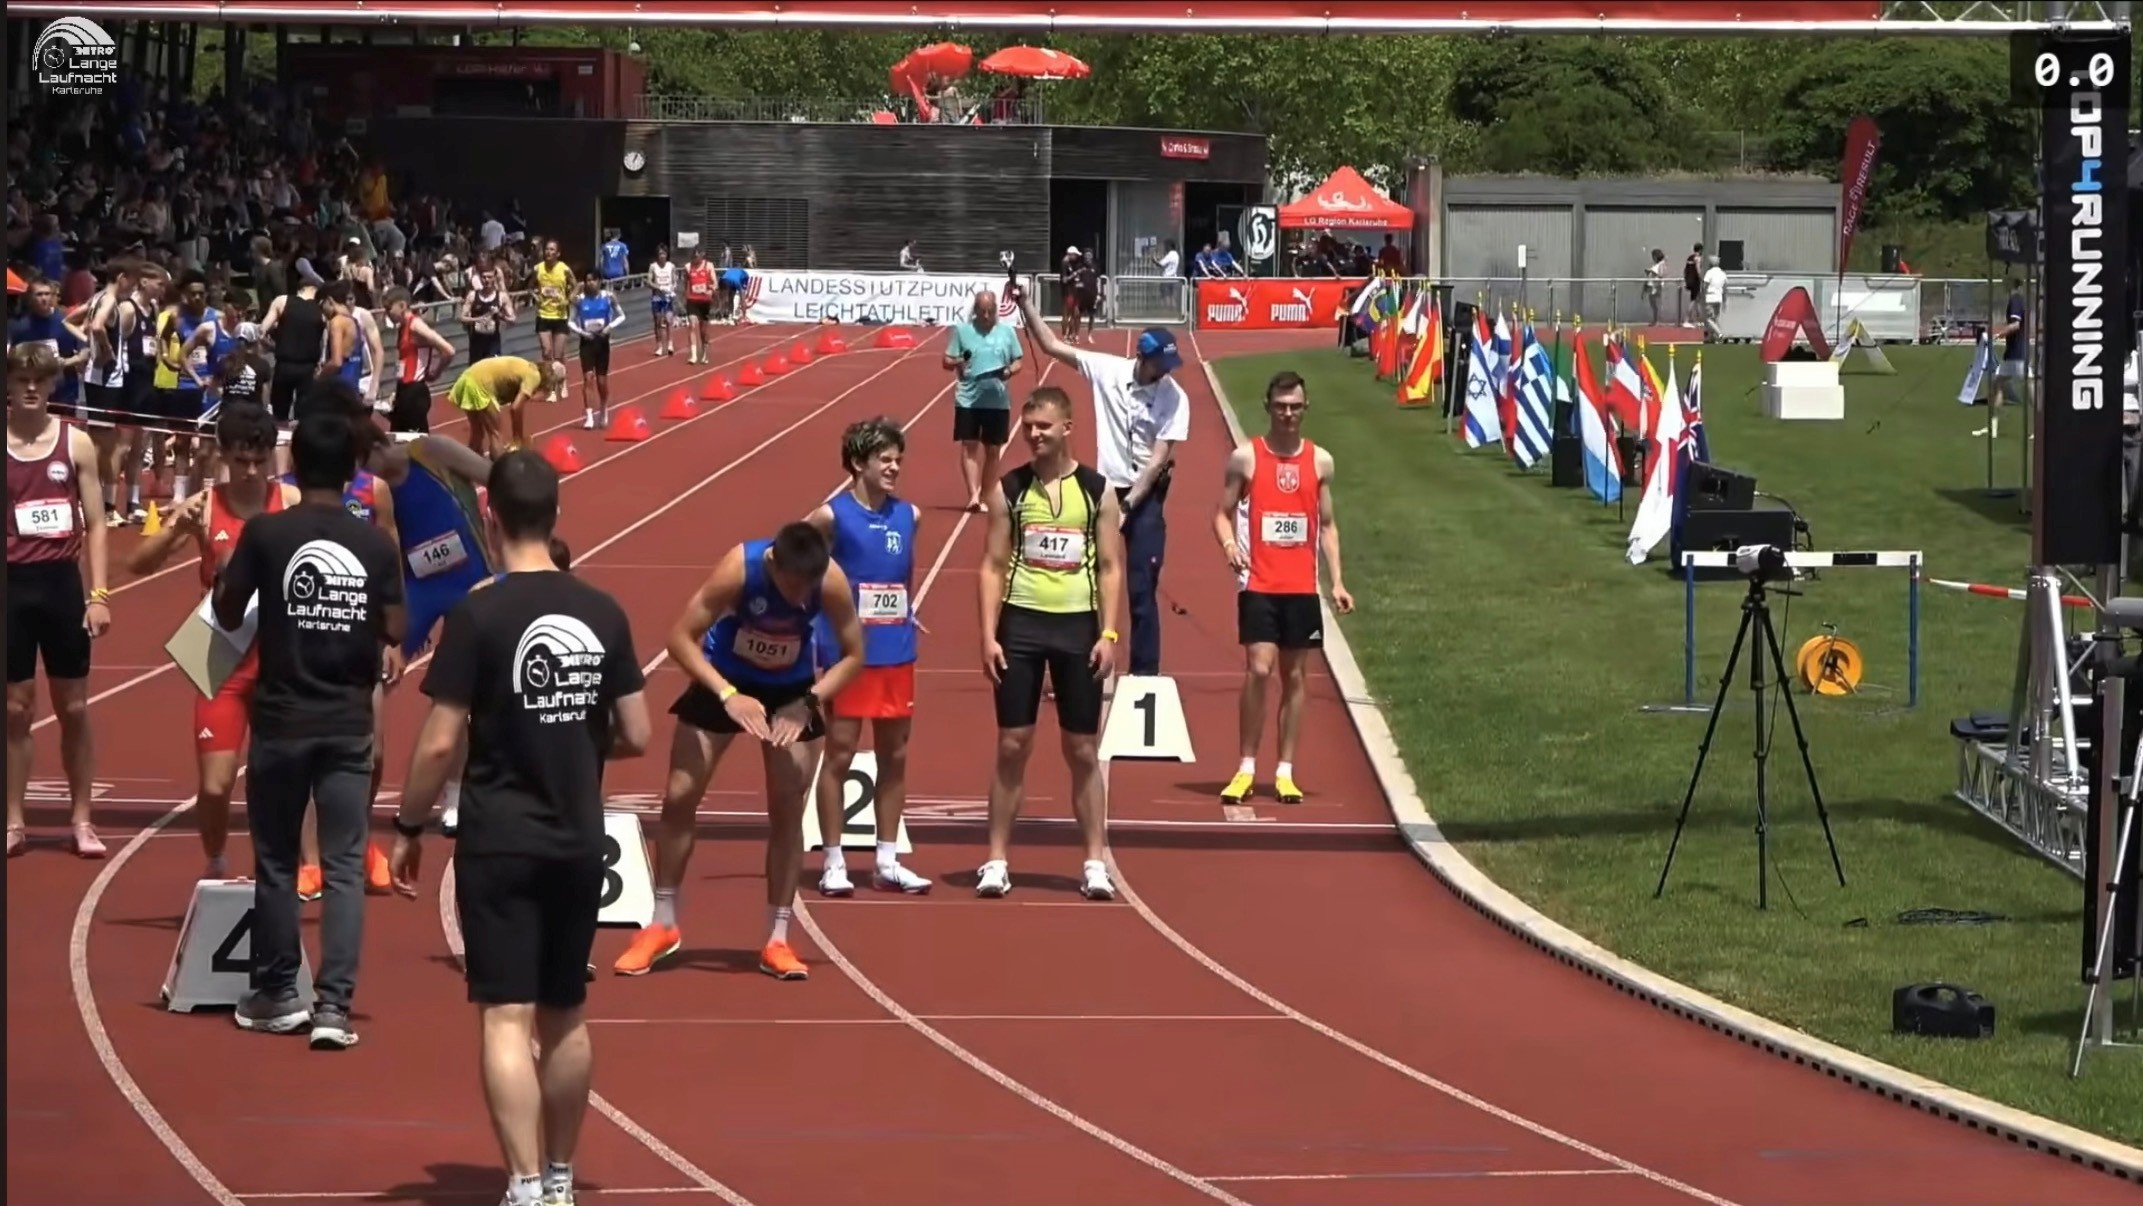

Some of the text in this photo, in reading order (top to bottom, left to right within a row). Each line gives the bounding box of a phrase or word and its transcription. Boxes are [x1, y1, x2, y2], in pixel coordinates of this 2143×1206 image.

[1318, 216, 1347, 227] Region
[793, 301, 966, 323] LEICHTATHLETIK
[1207, 304, 1243, 322] PUMA
[1270, 303, 1307, 322] PUMA
[31, 508, 59, 525] 581
[1274, 520, 1299, 534] 286
[1039, 536, 1069, 552] 417
[423, 543, 450, 564] 146
[323, 574, 366, 588] NITRO
[318, 586, 368, 606] Lange
[873, 594, 898, 608] 702
[286, 602, 367, 621] Laufnacht
[297, 618, 352, 632] Karlsruhe
[746, 639, 788, 656] 1051
[554, 671, 603, 688] Lage
[523, 690, 599, 709] Laufnaht
[1133, 692, 1157, 747] 1
[841, 769, 876, 835] 2
[211, 907, 263, 989] 4
